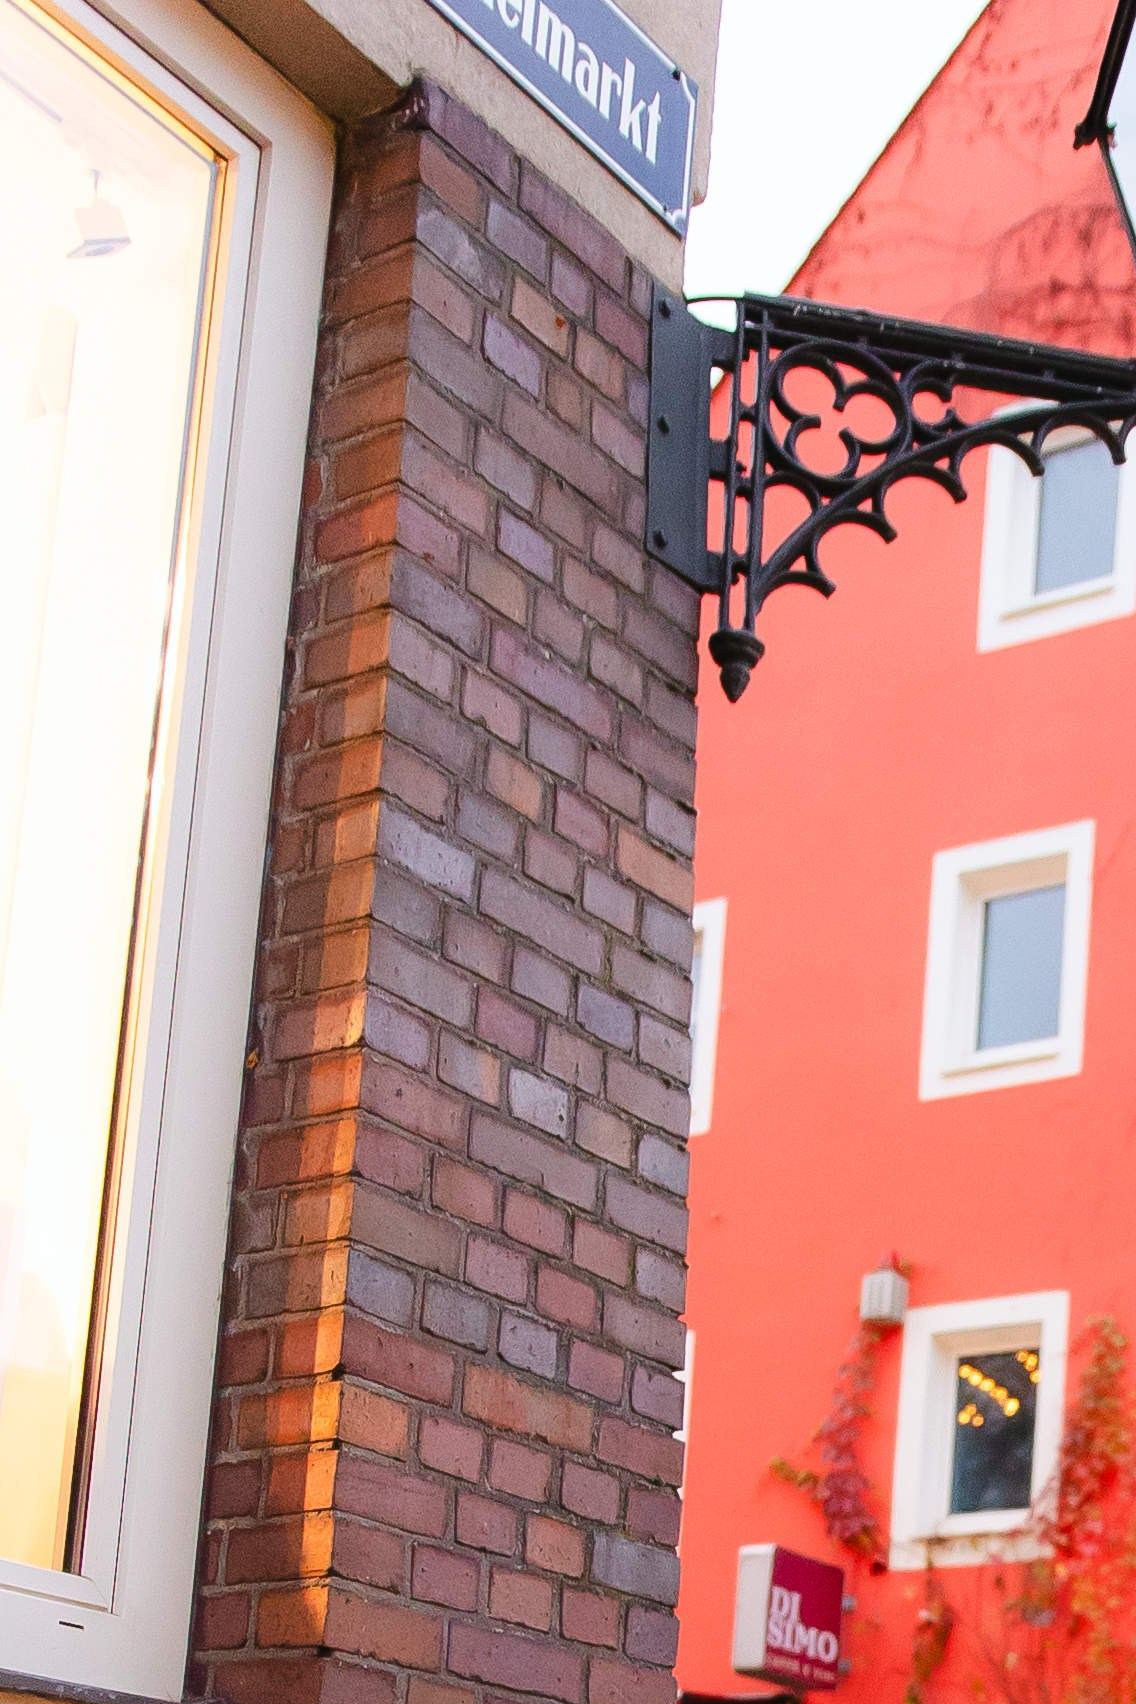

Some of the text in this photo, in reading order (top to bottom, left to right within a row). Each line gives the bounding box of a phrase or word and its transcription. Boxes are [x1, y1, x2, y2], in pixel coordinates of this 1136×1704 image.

[480, 0, 662, 166] elmarkt
[771, 1585, 801, 1619] DI
[767, 1614, 839, 1664] SIMO
